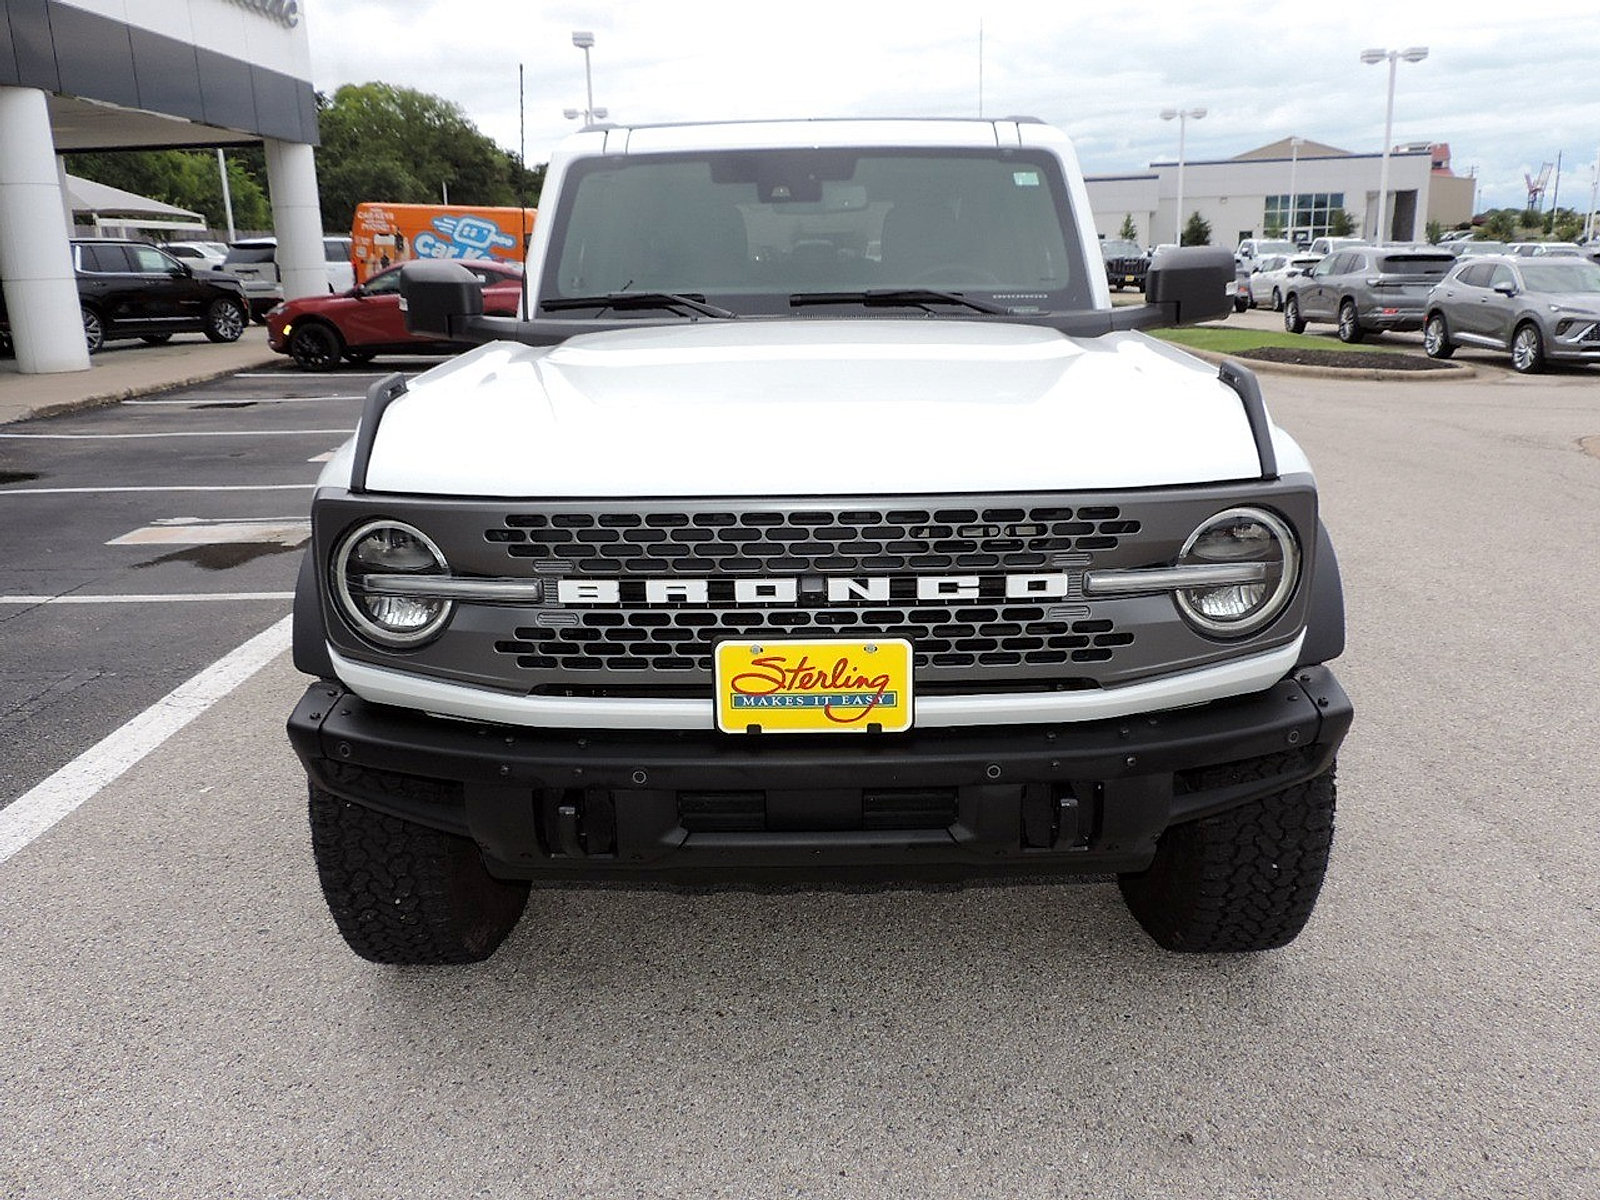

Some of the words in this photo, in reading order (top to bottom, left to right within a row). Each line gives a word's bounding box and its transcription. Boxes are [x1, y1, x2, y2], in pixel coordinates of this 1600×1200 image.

[415, 234, 459, 259] Car
[557, 572, 1068, 604] BRONCO
[731, 656, 890, 724] Sterling
[742, 696, 804, 707] MAKES
[814, 696, 831, 707] IT
[842, 694, 886, 706] EASY
